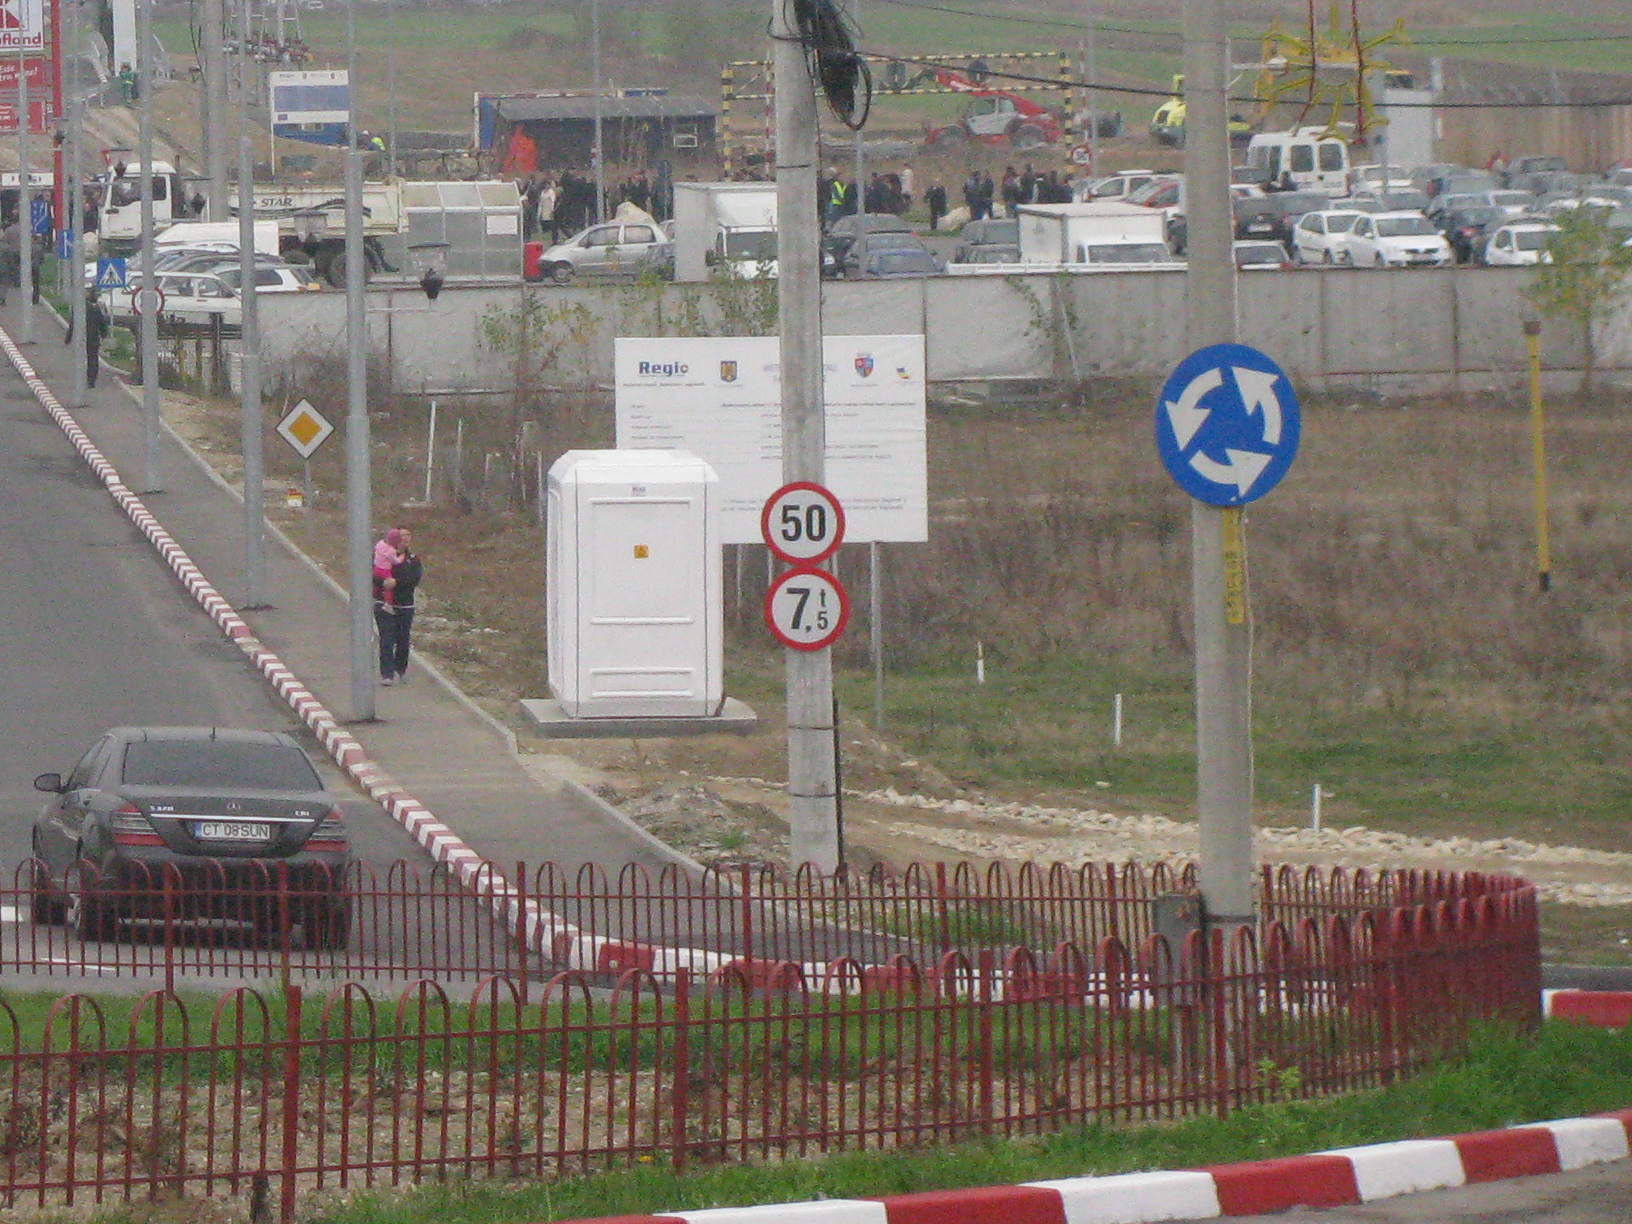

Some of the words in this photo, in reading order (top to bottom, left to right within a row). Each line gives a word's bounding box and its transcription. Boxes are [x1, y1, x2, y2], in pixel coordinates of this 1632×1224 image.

[261, 197, 293, 208] STAR
[638, 361, 689, 377] Regio
[781, 504, 826, 542] 50
[202, 825, 219, 836] CT
[240, 825, 268, 837] SUN
